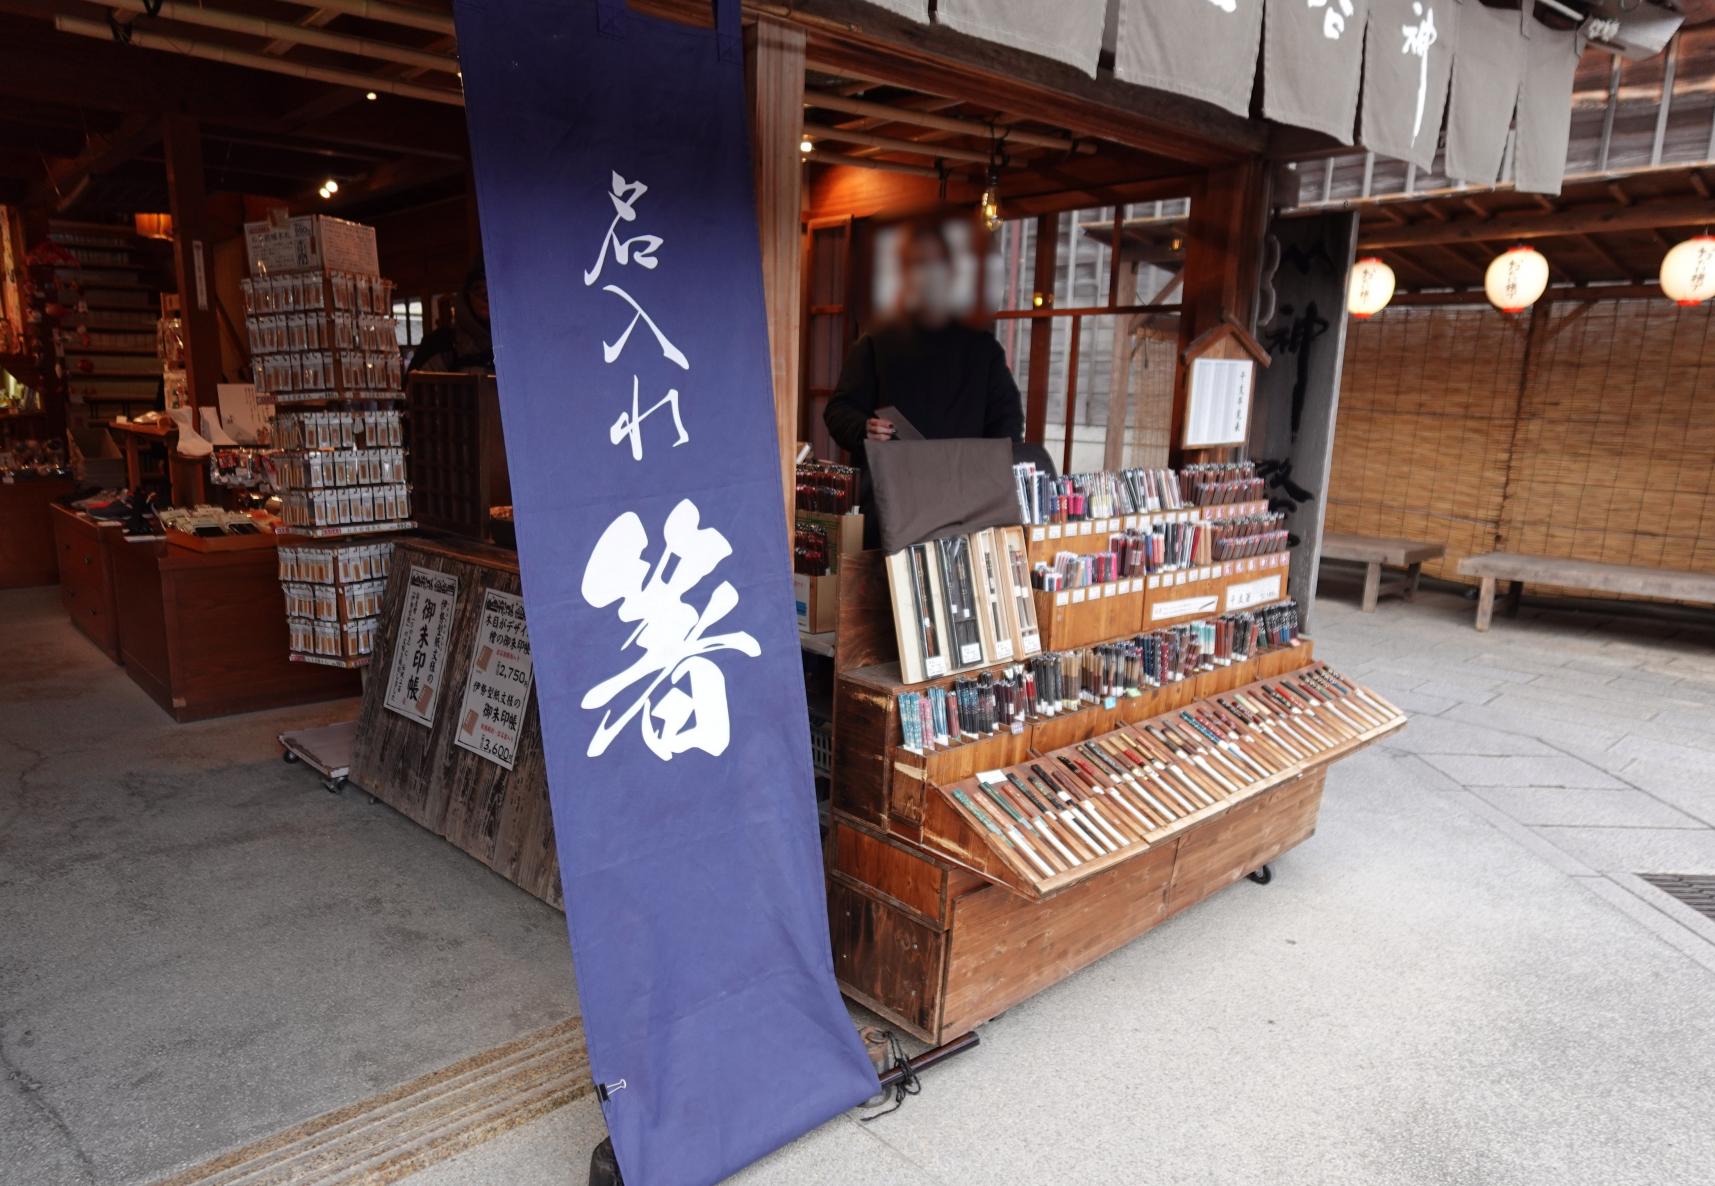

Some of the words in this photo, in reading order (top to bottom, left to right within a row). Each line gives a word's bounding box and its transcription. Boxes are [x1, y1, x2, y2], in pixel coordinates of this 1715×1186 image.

[405, 598, 437, 702] 御朱印帳
[473, 681, 521, 709] 伊勢型紙文様の
[482, 703, 518, 732] 御朱印帳
